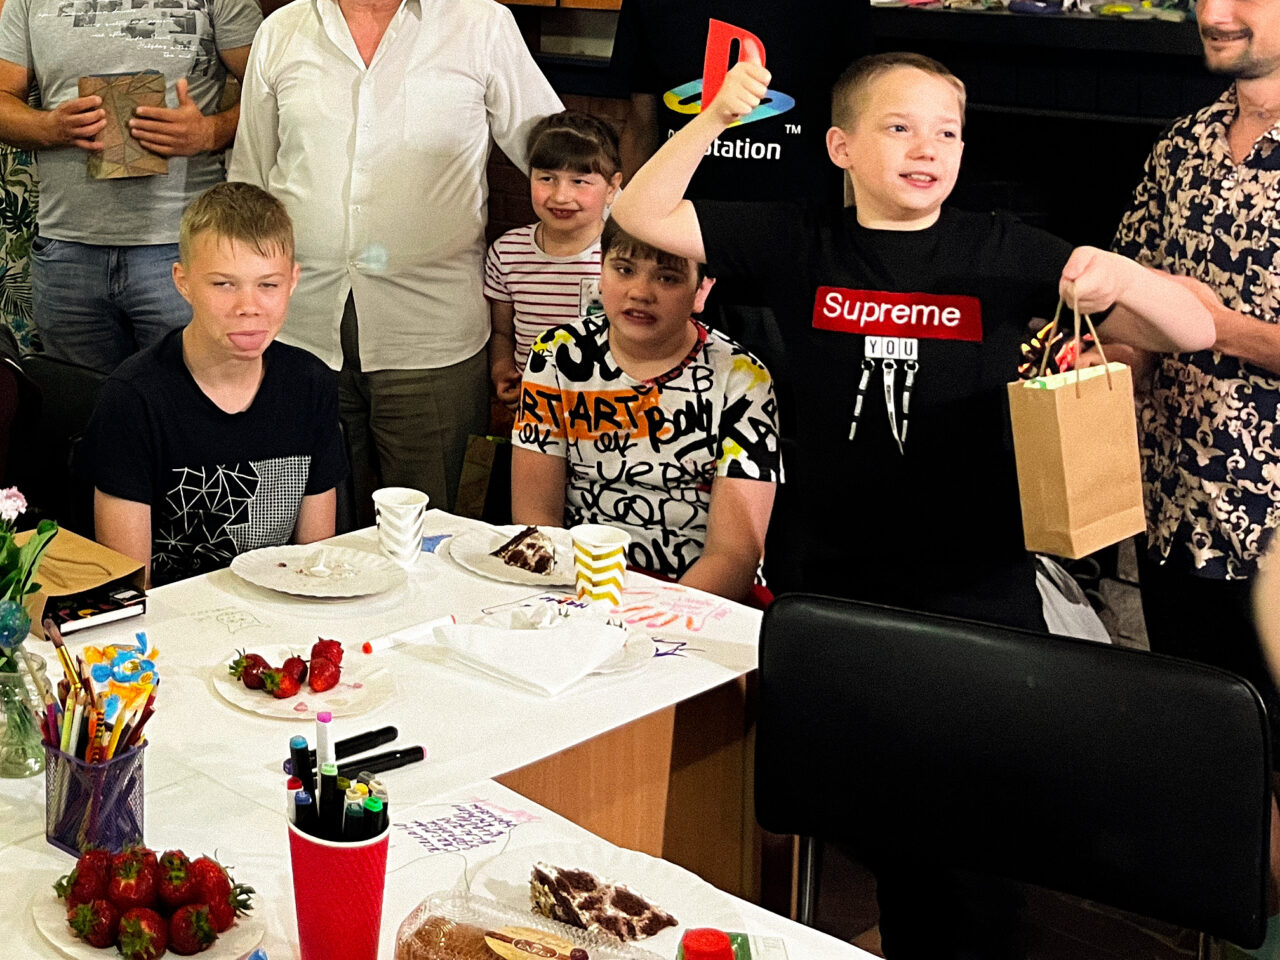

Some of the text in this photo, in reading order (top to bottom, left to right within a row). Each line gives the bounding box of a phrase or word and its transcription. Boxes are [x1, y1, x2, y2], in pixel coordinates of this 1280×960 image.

[785, 124, 802, 134] TM
[822, 291, 962, 328] Supreme
[570, 391, 640, 433] ART
